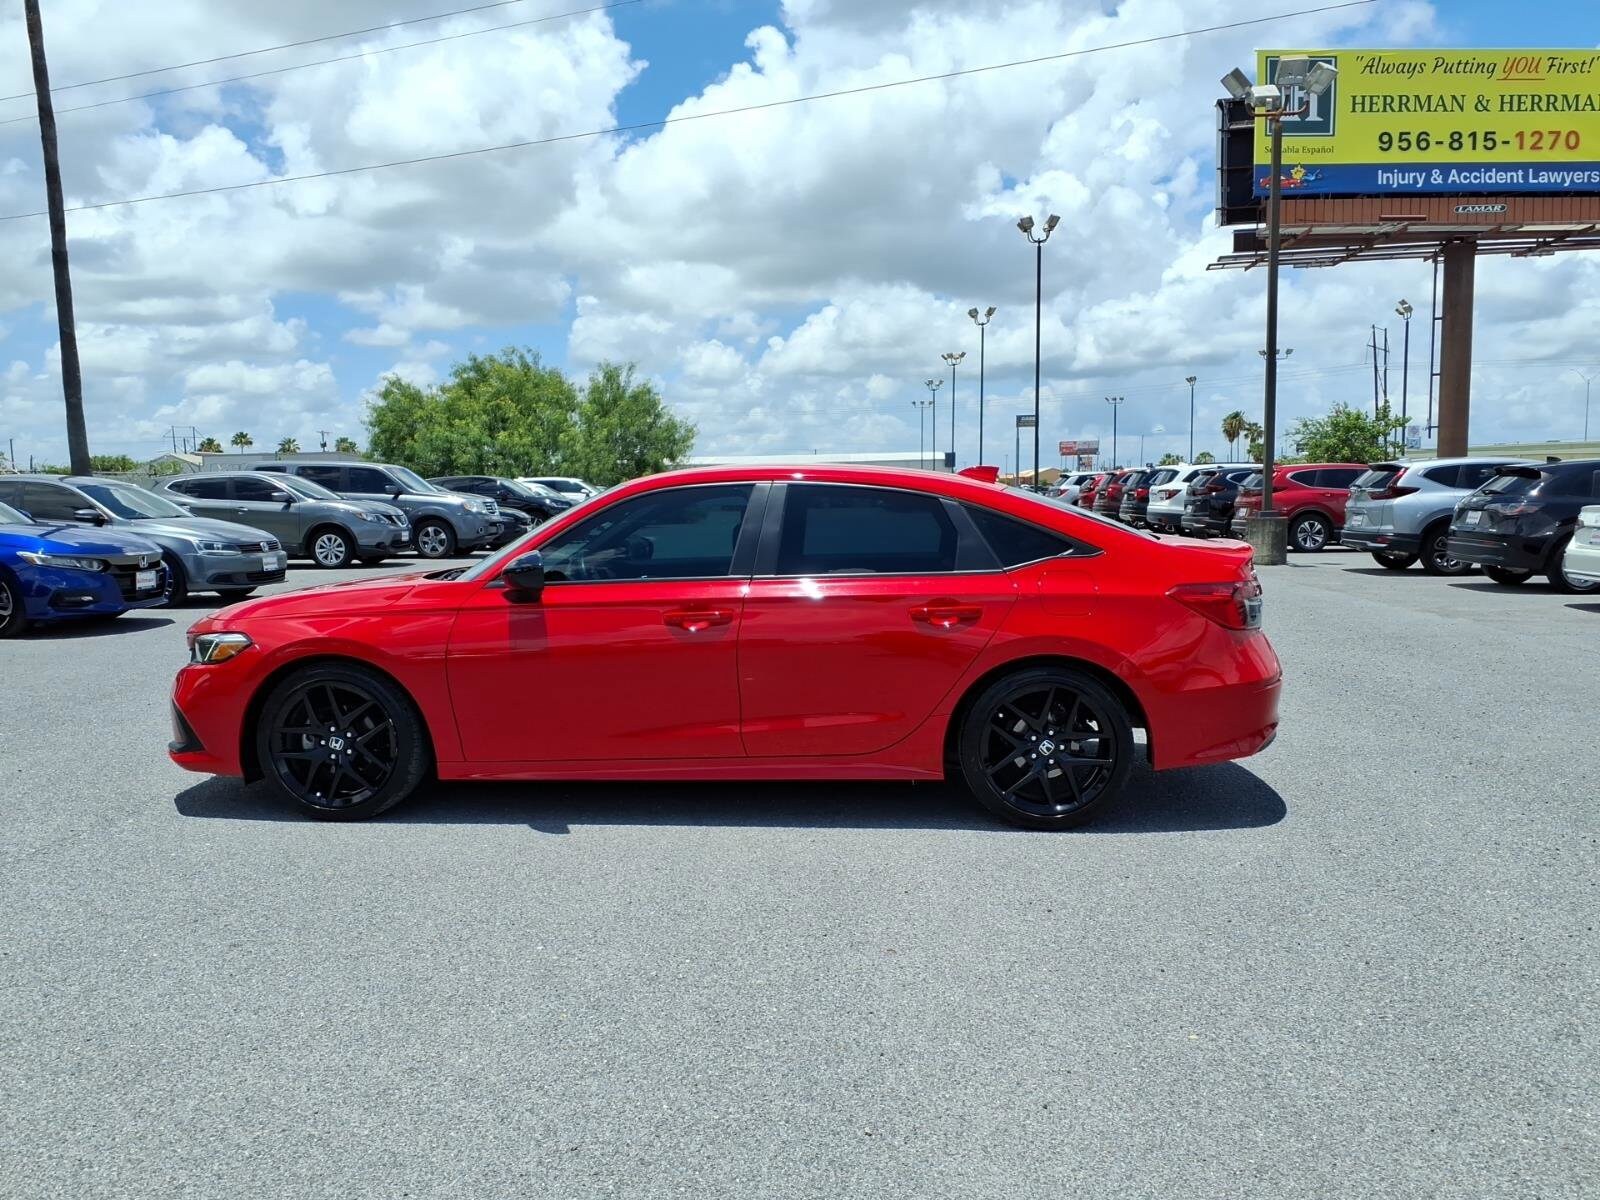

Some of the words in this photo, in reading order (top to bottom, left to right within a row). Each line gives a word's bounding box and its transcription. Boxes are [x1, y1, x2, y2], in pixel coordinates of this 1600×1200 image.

[1431, 56, 1497, 80] Putting
[1350, 94, 1467, 113] HERRMAN
[1474, 94, 1491, 113] &
[1498, 94, 1600, 113] HERRMA
[1302, 145, 1334, 155] Español
[1378, 130, 1581, 152] 956-815-1270
[1377, 168, 1426, 188] Injury
[1430, 168, 1443, 184] &
[1447, 167, 1524, 184] Accident
[1528, 168, 1600, 187] Lawyers
[1458, 205, 1502, 213] LAMAR
